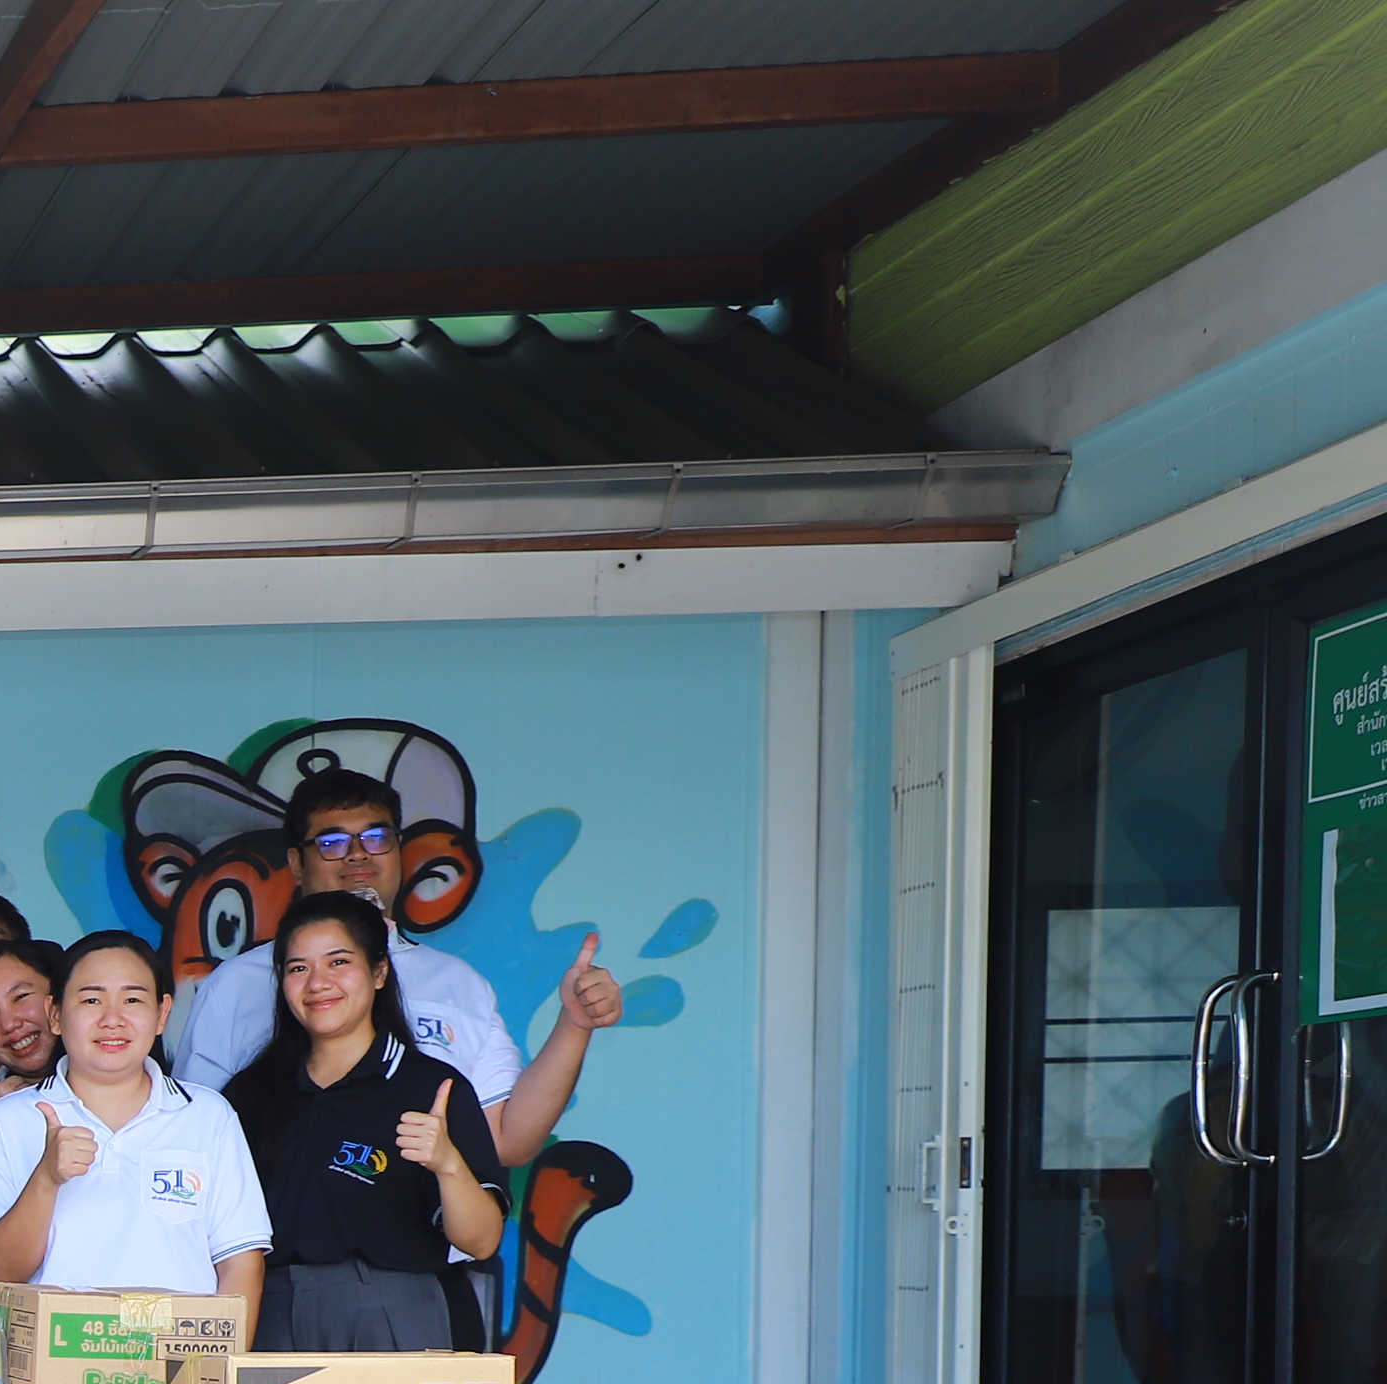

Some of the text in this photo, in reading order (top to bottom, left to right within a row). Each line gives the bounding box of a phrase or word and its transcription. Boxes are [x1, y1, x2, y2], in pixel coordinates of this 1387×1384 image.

[416, 1016, 444, 1039] 51
[332, 1140, 373, 1166] 51
[151, 1169, 186, 1195] 51
[55, 1325, 67, 1346] L
[82, 1320, 104, 1336] 48
